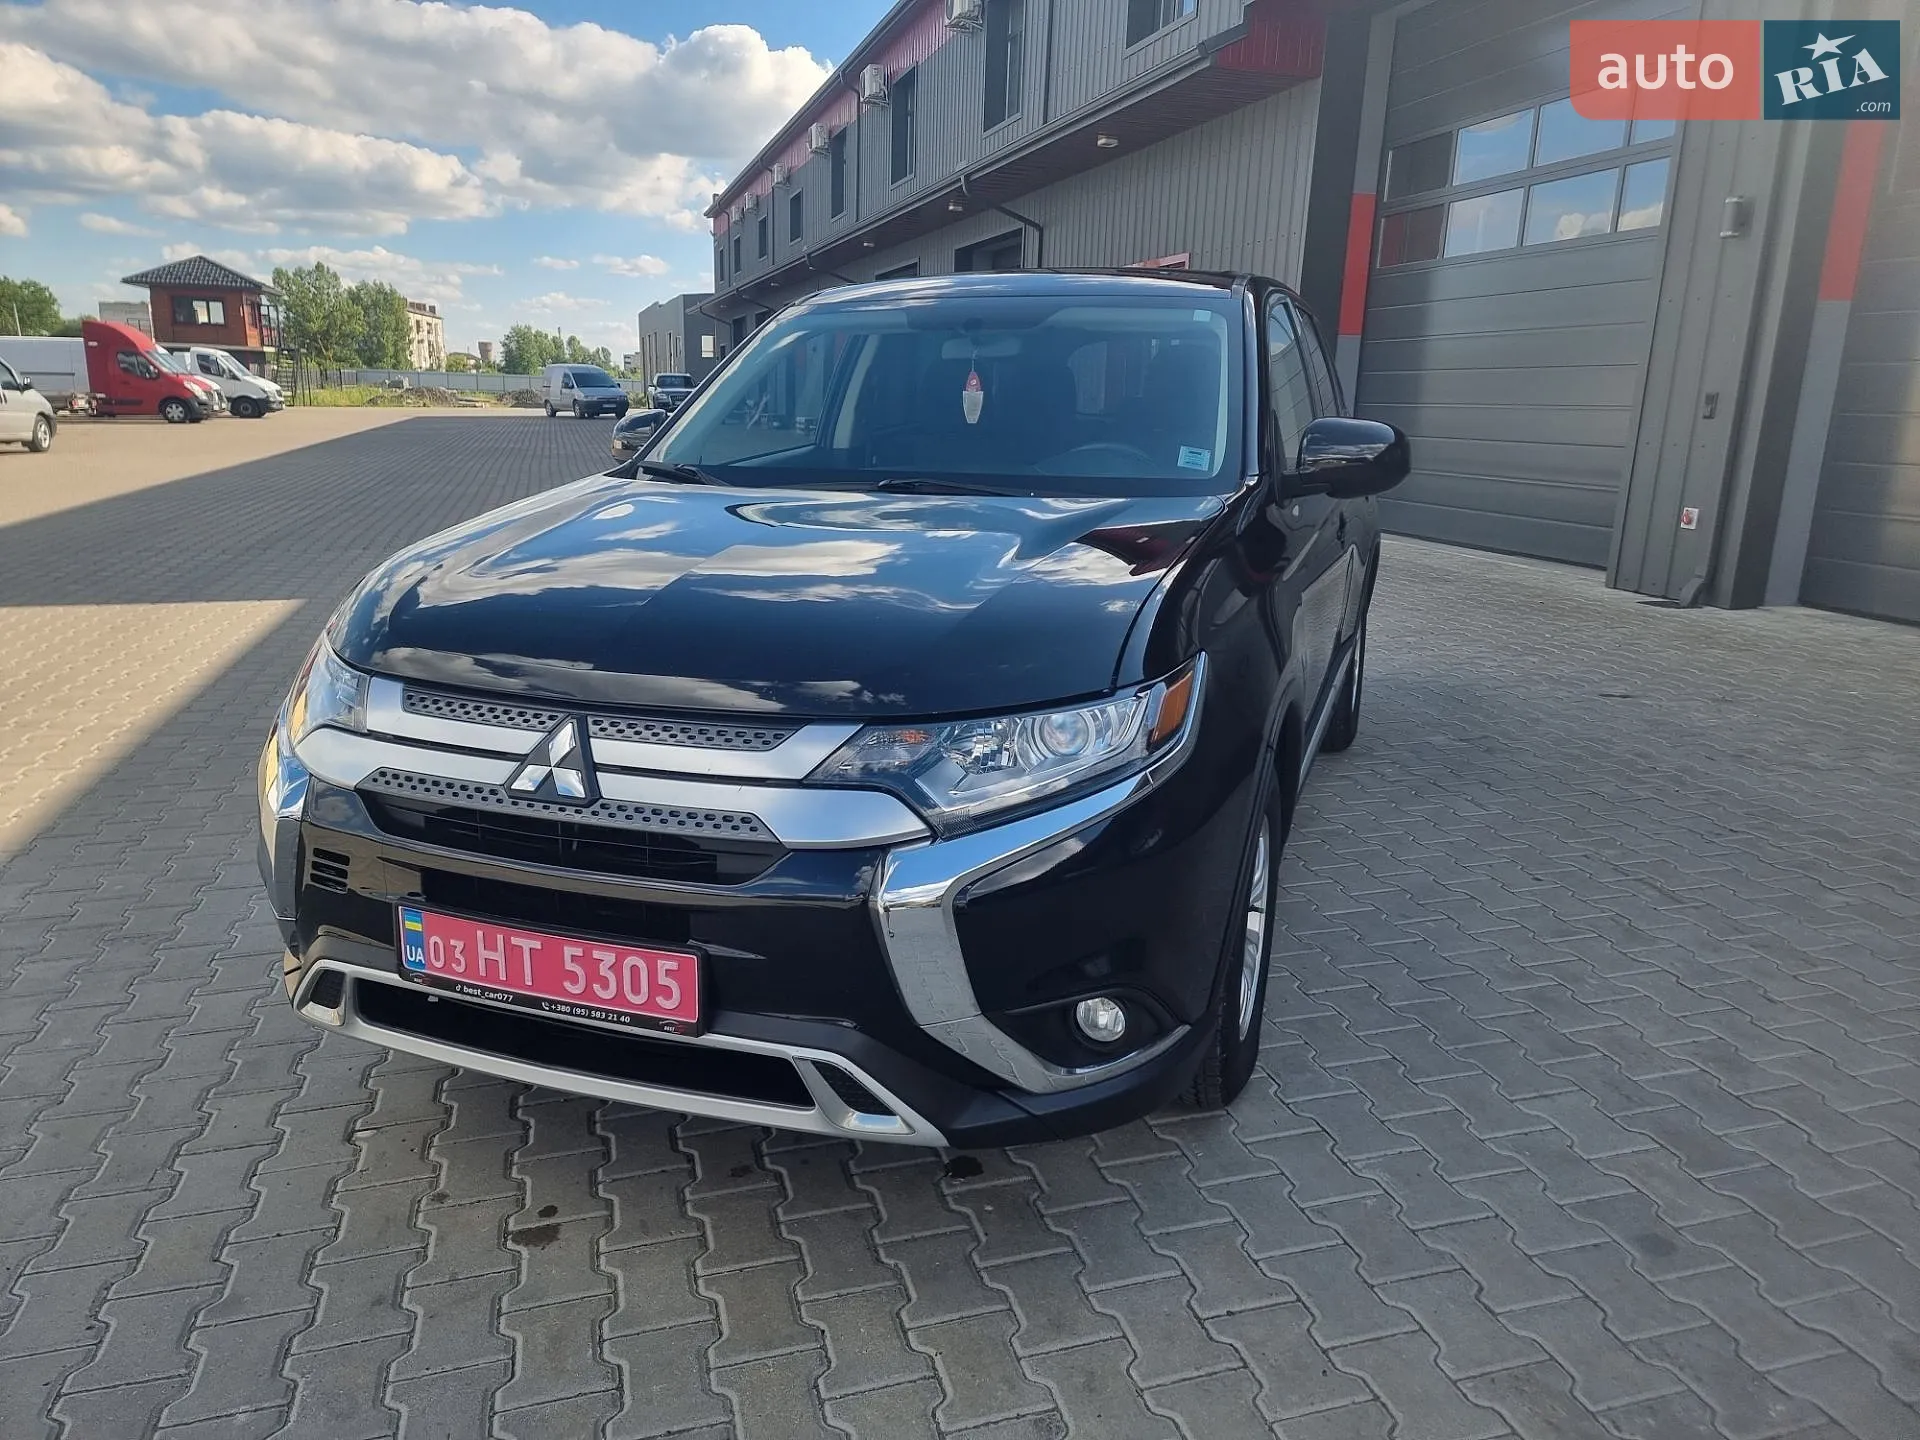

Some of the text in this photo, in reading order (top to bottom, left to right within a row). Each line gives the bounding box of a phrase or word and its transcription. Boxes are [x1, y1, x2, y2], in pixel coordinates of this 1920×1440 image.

[406, 945, 425, 964] UA
[428, 930, 682, 1011] 03 HT 5305
[463, 985, 514, 1002] best_car077
[550, 1003, 571, 1013] +380
[573, 1006, 589, 1017] (95)
[607, 1013, 618, 1021] 21
[619, 1015, 631, 1024] 40
